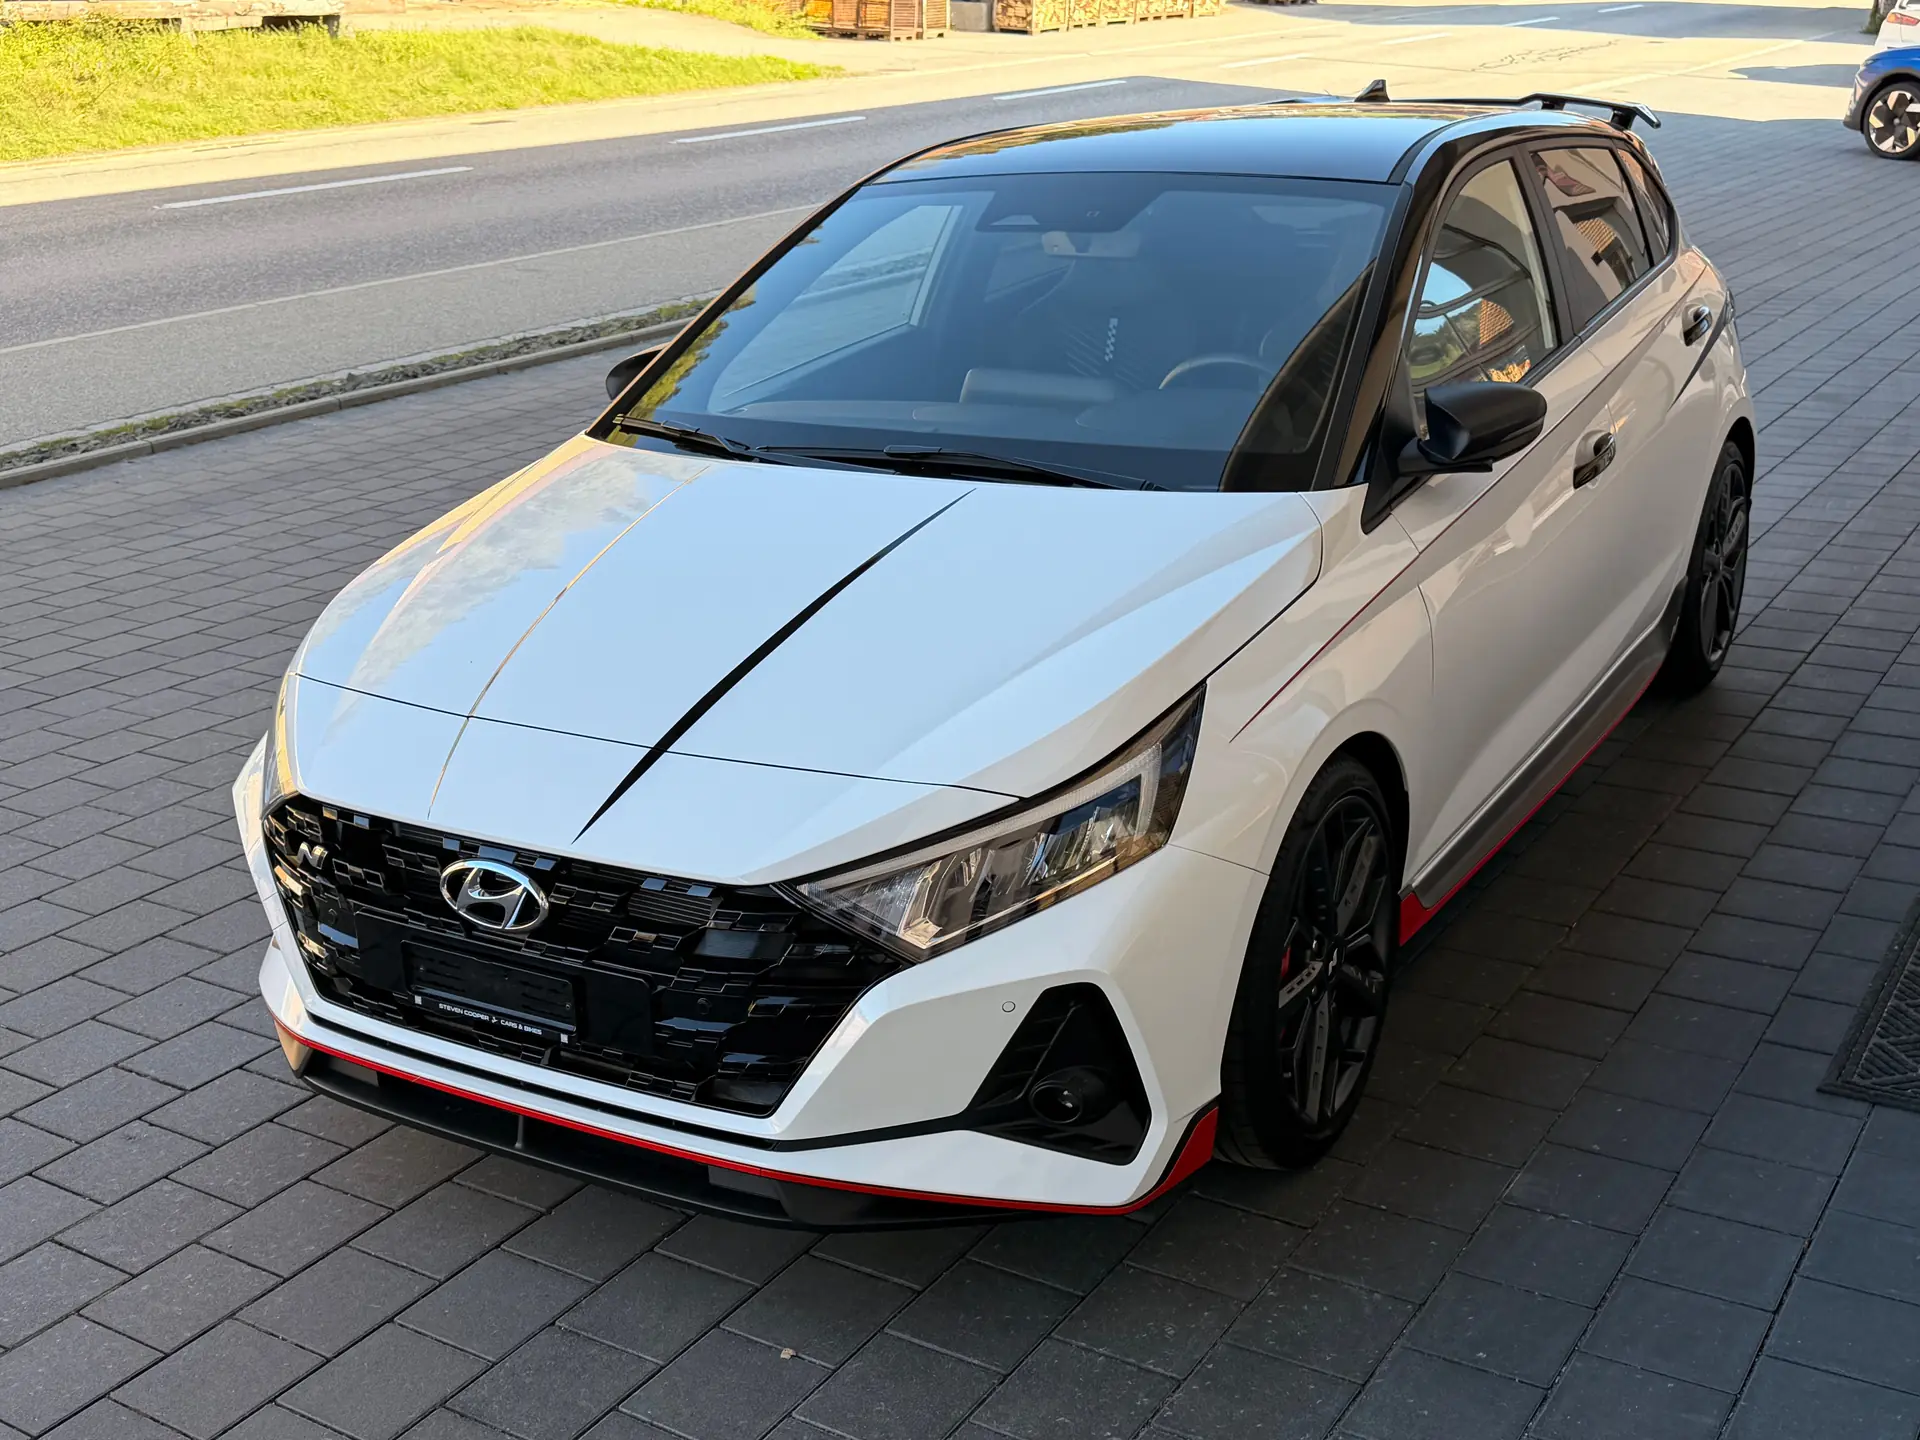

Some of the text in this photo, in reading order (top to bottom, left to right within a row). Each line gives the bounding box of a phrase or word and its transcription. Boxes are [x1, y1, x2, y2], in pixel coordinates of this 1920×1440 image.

[439, 1003, 463, 1014] STEVEN
[464, 1010, 489, 1021] COOPER
[501, 1020, 517, 1028] CARS
[524, 1026, 542, 1035] BIKES
